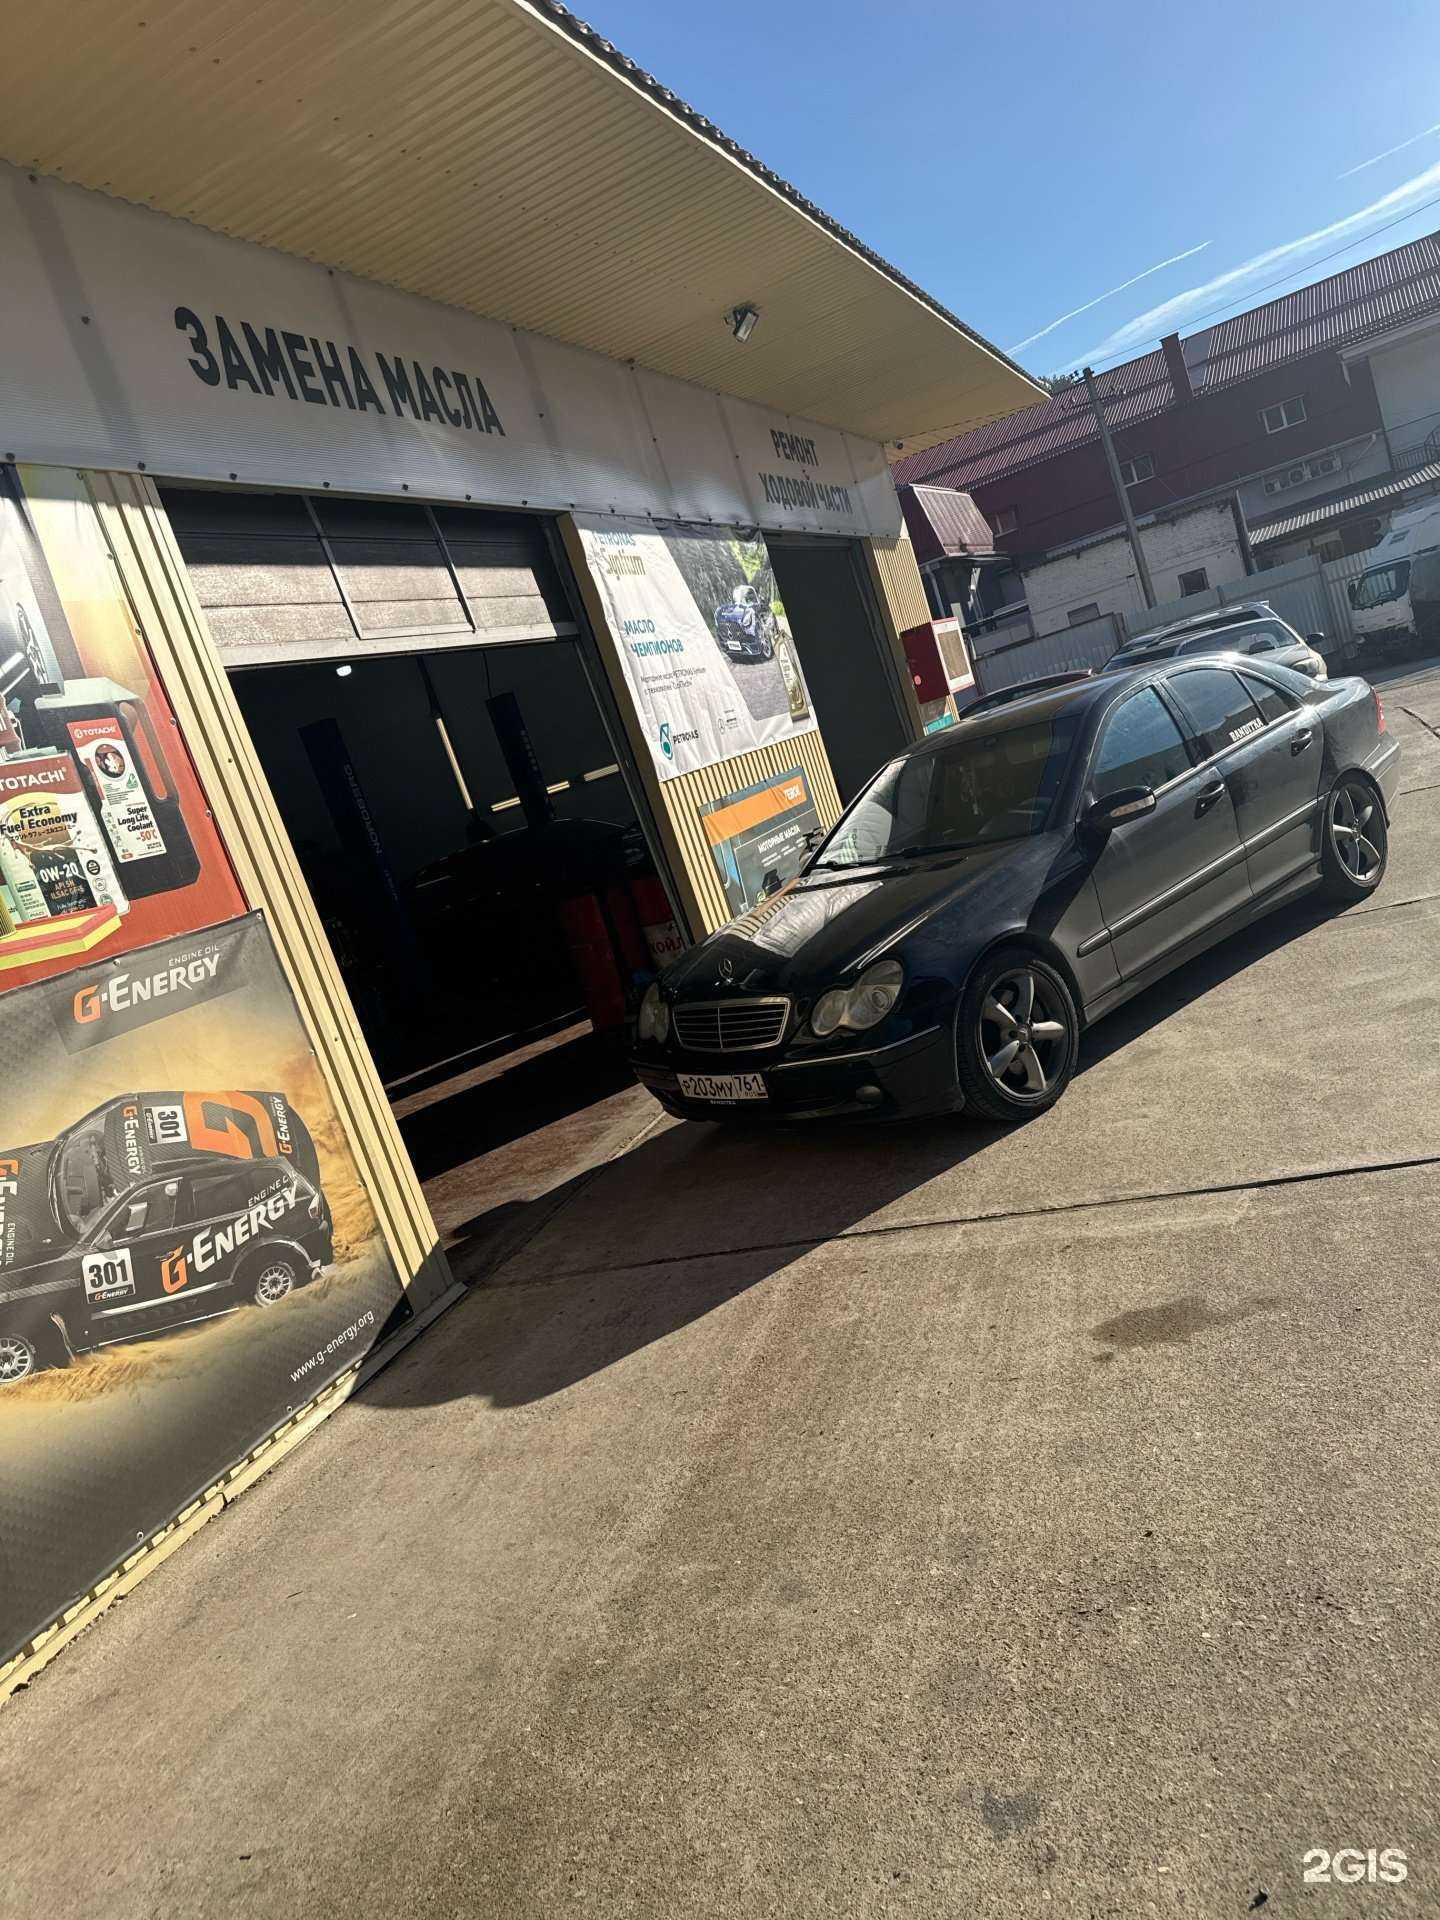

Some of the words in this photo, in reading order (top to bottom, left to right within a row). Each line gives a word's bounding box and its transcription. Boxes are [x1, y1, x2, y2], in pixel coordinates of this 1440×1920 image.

[174, 306, 386, 415] ЗАМЕНА
[375, 351, 506, 437] МАСЛА
[769, 428, 819, 467] РЕМОНТ
[758, 470, 820, 511] ХОДОВОЙ
[815, 482, 853, 514] ЧАСТИ
[624, 619, 655, 636] МАСЛО
[631, 638, 684, 657] ЧЕМПИОНОВ
[83, 726, 116, 737] TOTACHI
[673, 729, 699, 744] PETRONAS
[19, 805, 51, 818] Extra
[117, 814, 136, 826] Long
[135, 814, 149, 823] Life
[127, 806, 148, 815] Super
[0, 820, 25, 834] Fuel
[28, 812, 78, 830] Economy
[127, 821, 154, 833] Coolant
[40, 862, 79, 883] 0W-20
[169, 950, 203, 966] ENGINE
[205, 944, 219, 954] OIL
[157, 1110, 182, 1139] 301
[248, 1181, 281, 1206] ENGINE
[7, 1222, 16, 1251] ENGINE
[5, 1252, 15, 1266] OIL
[88, 1259, 129, 1289] 301
[290, 1310, 375, 1382] www.g-energy.org
